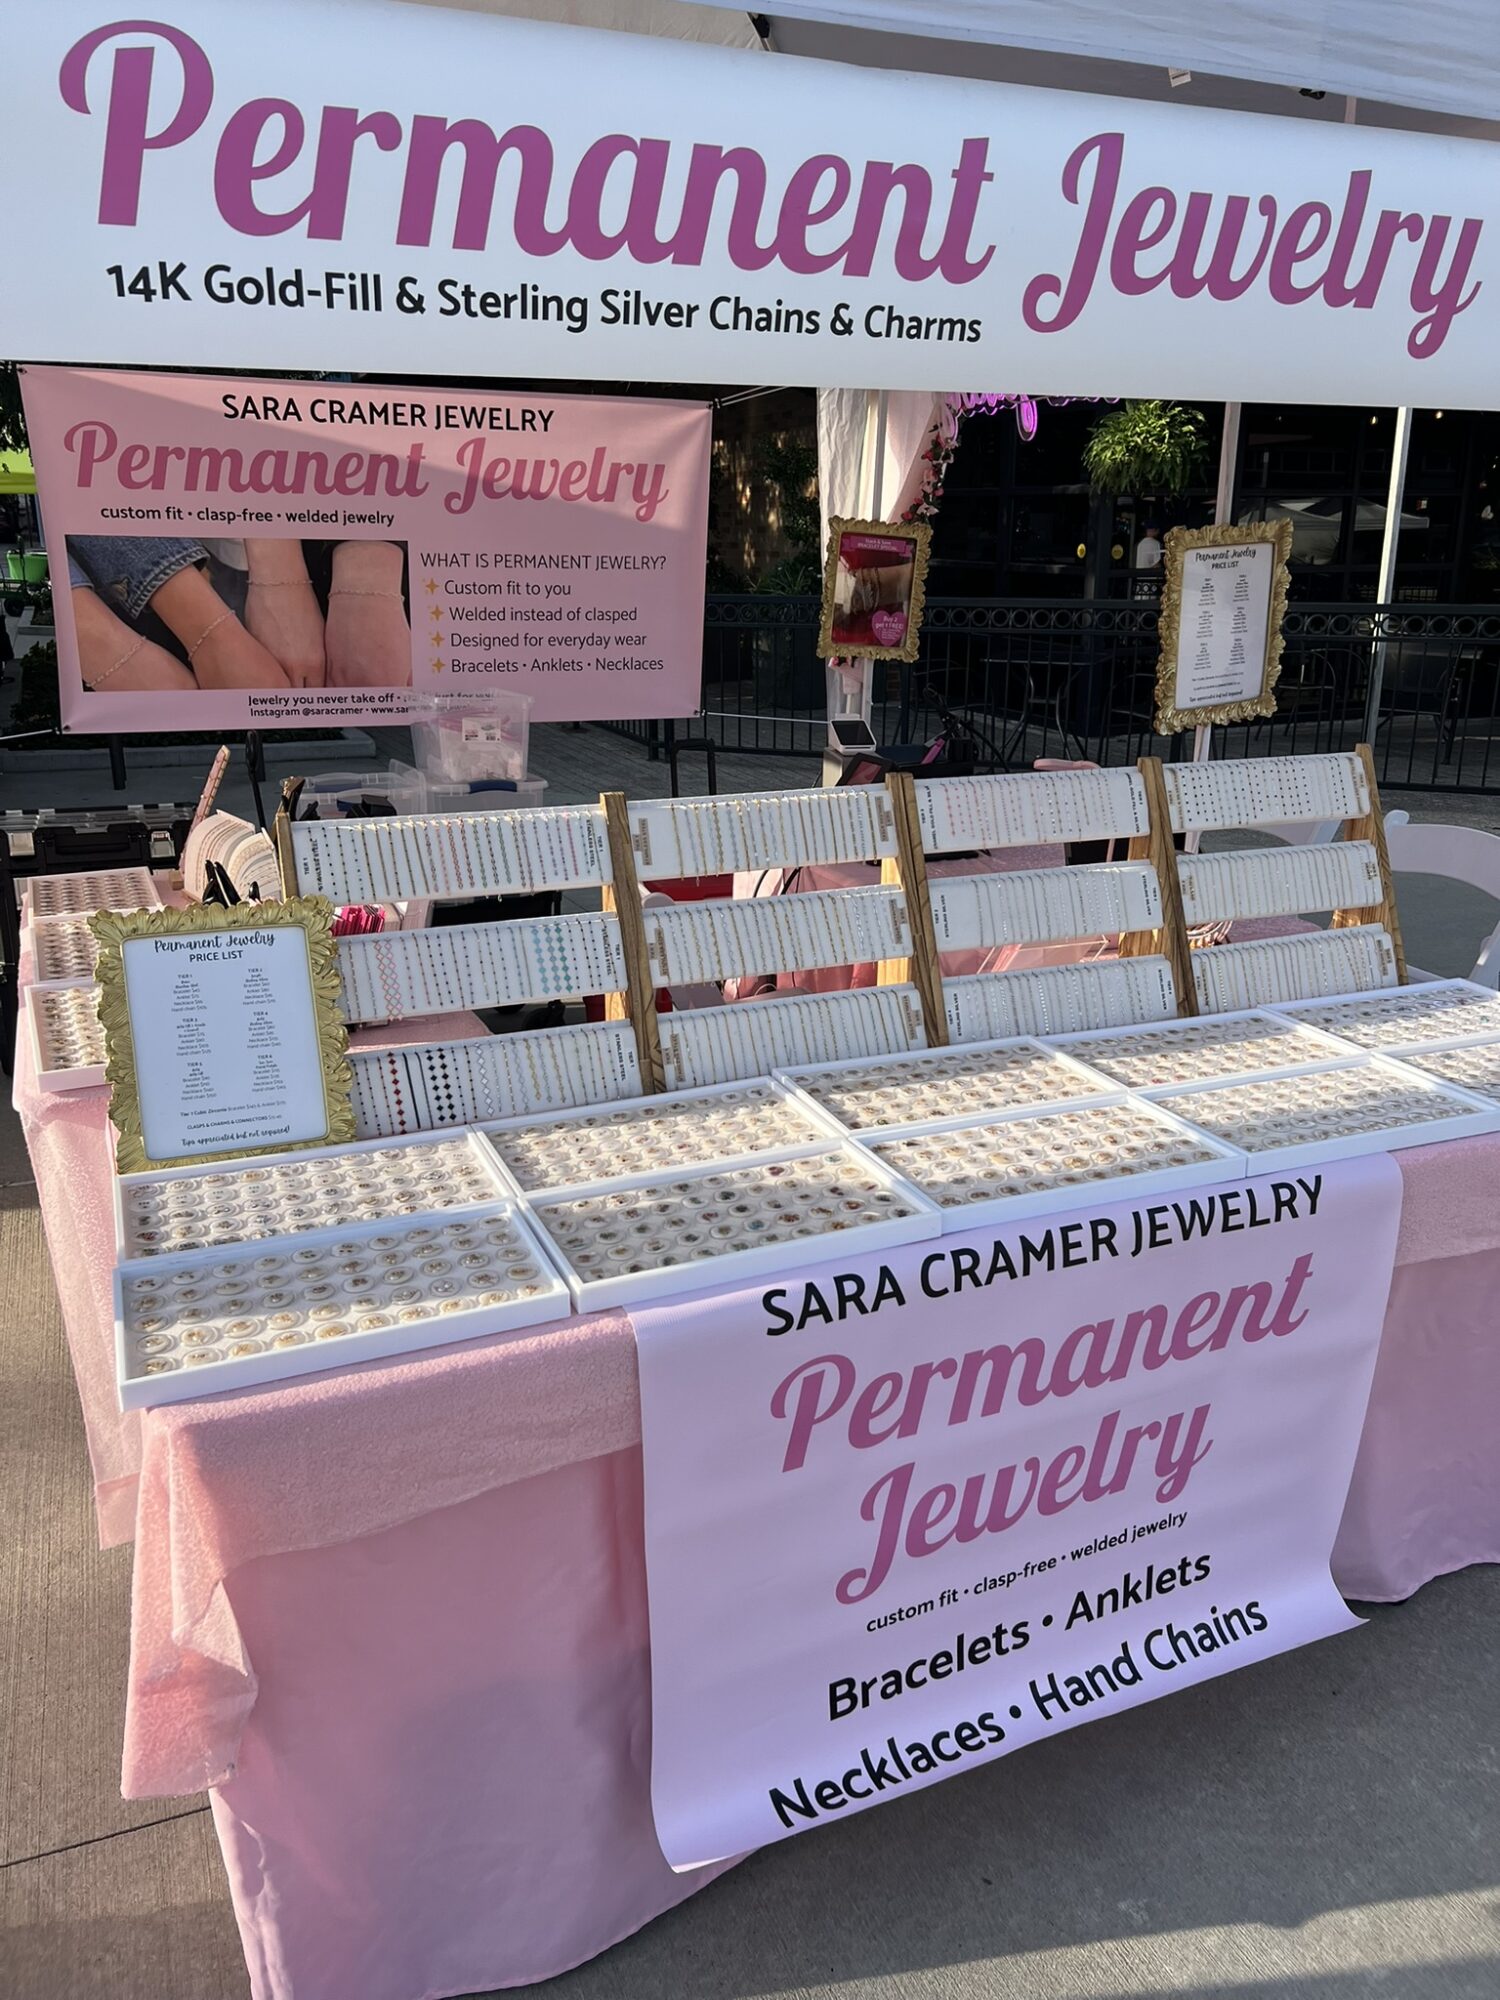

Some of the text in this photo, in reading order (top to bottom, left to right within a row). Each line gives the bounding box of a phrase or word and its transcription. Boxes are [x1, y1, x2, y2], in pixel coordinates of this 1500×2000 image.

[59, 20, 1483, 360] Permanent Jewelry
[106, 261, 982, 343] 14K Gold-Fill & Sterling Silver Chains & Charms
[222, 394, 555, 432] SARA CRAMER JEWELRY
[64, 421, 669, 522] Permanent Jewelry
[100, 506, 395, 527] custom fit clasp-free welded jewelry
[420, 553, 667, 571] WHAT IS PERMANENT JEWELRY?
[444, 580, 571, 599] Custom fit to you
[449, 607, 637, 625] Welded instead of clasped
[450, 633, 647, 650] Designed for everyday wear
[451, 657, 664, 673] Bracelets Anklets Necklaces
[248, 695, 289, 707] Jewelry
[293, 696, 314, 707] you
[317, 694, 348, 705] never
[351, 693, 374, 704] take
[377, 693, 394, 703] off
[250, 707, 300, 719] Instagram
[302, 706, 364, 717] @saracramer
[154, 930, 275, 953] Permanent Jewelry
[189, 950, 243, 963] PRICE LIST
[615, 1033, 624, 1063] STAINLESS
[762, 1174, 1323, 1336] SARA CRAMER JEWELRY
[770, 1252, 1314, 1473] Permanent
[835, 1403, 1213, 1605] Jewelry
[866, 1510, 1188, 1632] custom fit clasp-free welded jewelry
[828, 1553, 1212, 1721] Bracelets Anklets
[769, 1601, 1269, 1829] Necklaces Hand Chains
